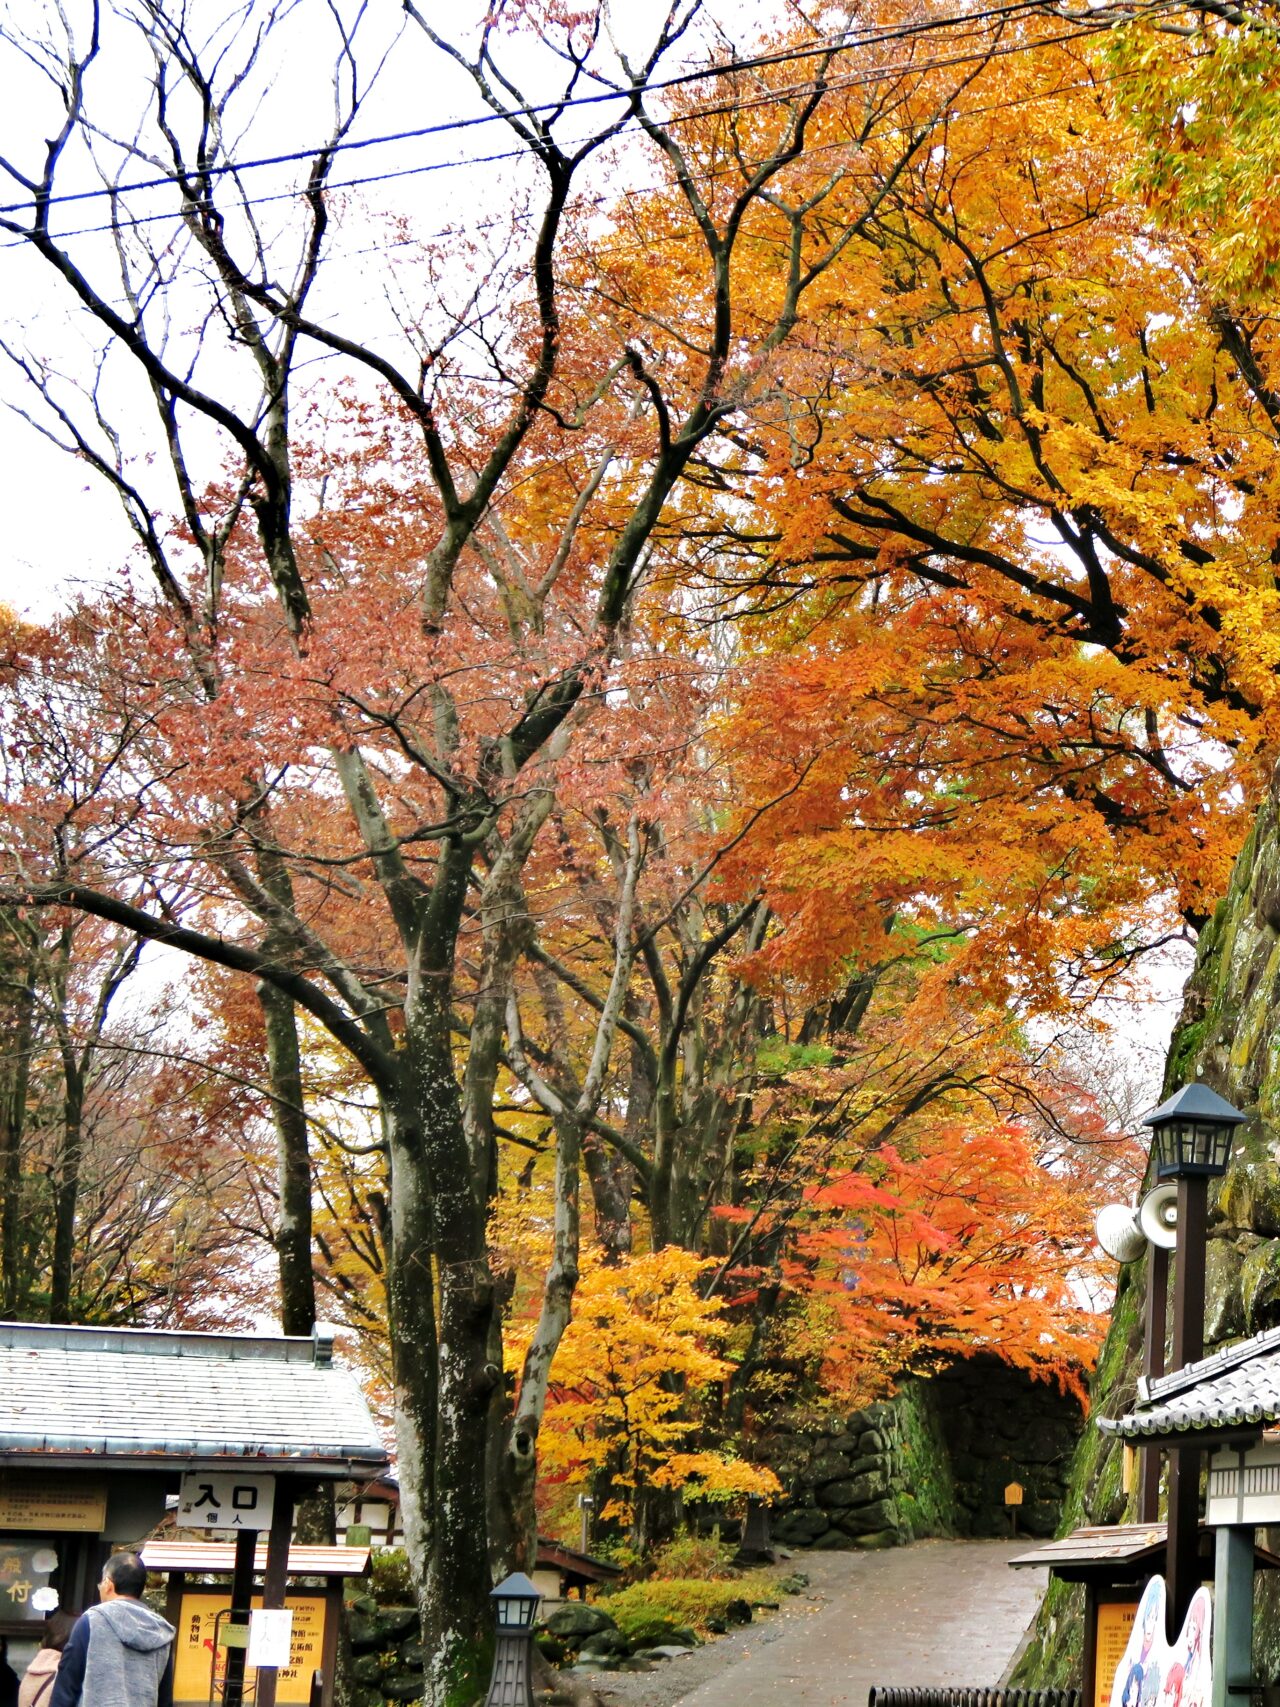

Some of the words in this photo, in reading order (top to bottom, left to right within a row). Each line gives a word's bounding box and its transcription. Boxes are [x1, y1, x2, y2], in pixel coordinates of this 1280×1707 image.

[194, 1484, 258, 1510] 入口
[206, 1512, 243, 1524] 個人
[189, 1614, 201, 1643] 動物園
